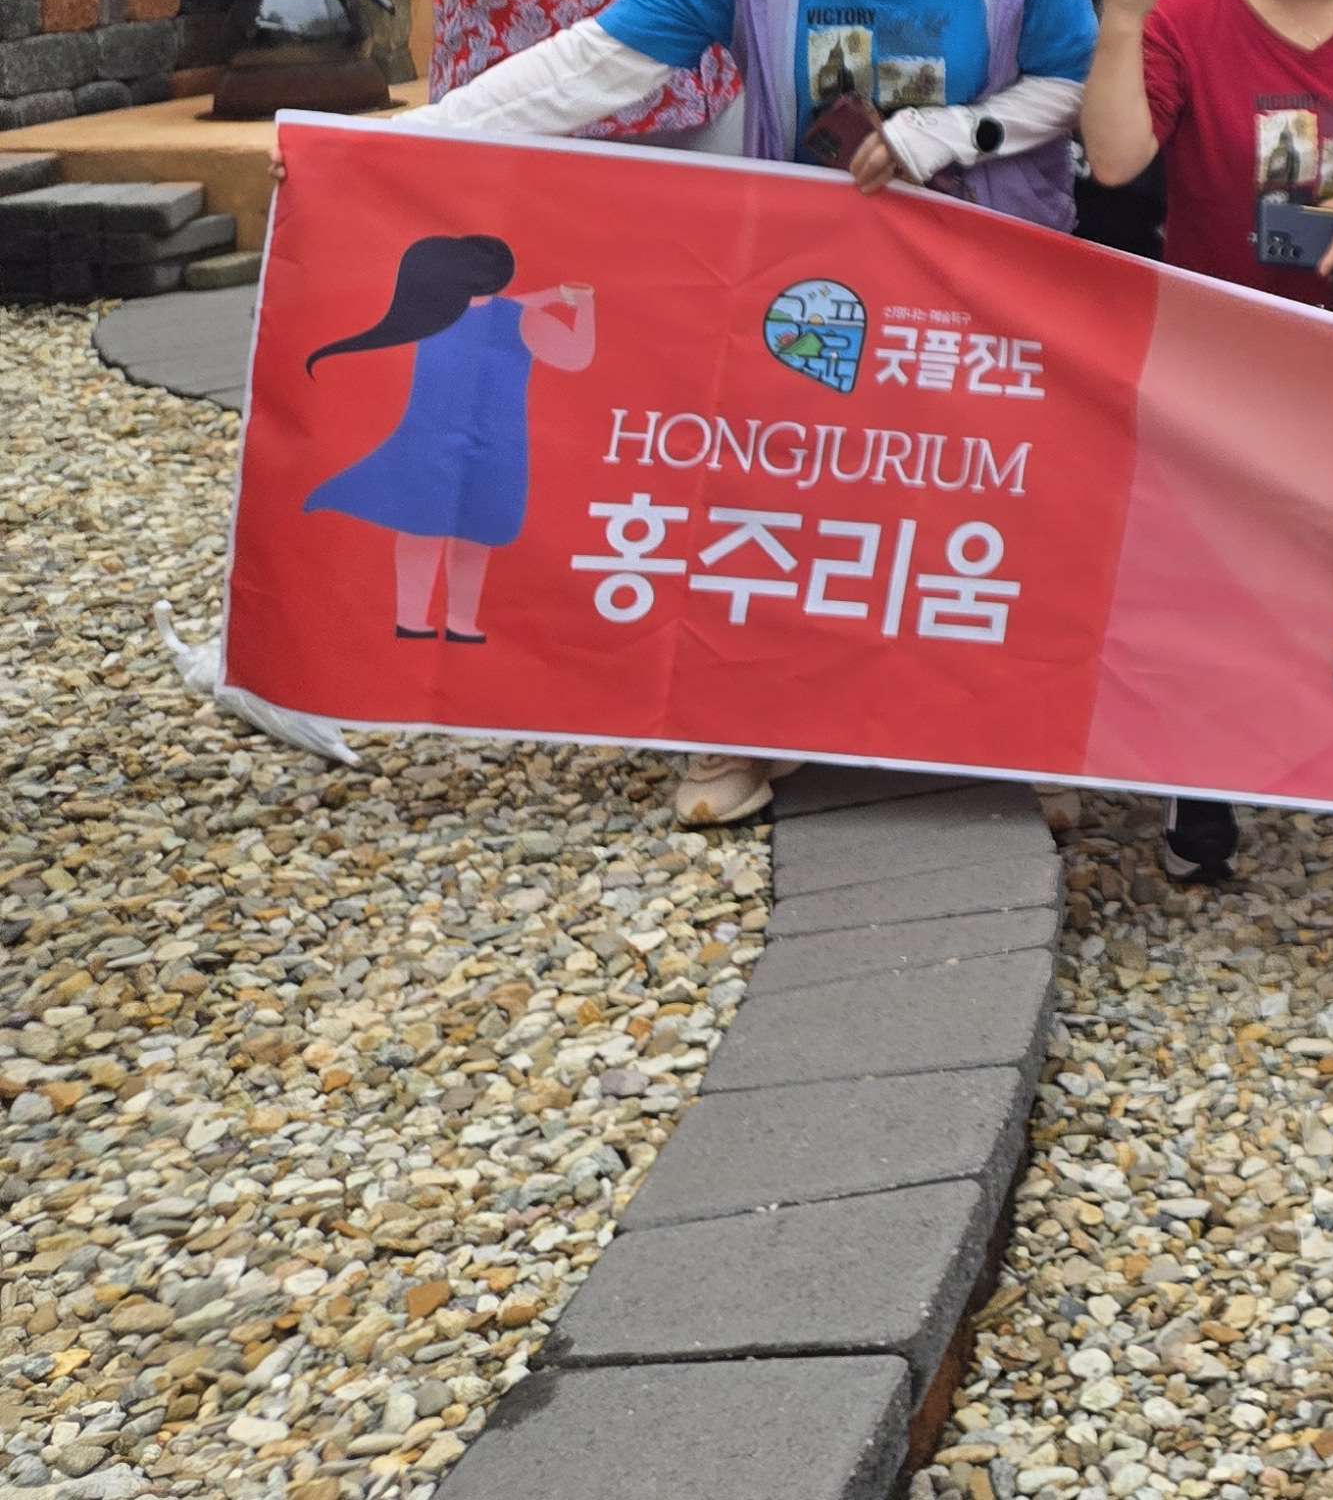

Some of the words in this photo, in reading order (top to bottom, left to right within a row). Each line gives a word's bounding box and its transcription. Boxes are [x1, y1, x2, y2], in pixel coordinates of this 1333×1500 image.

[807, 8, 875, 25] VICTORY
[875, 325, 1045, 399] 굿플진도
[602, 408, 1032, 497] HONGJURIUM
[571, 493, 1021, 645] 홍주리움
